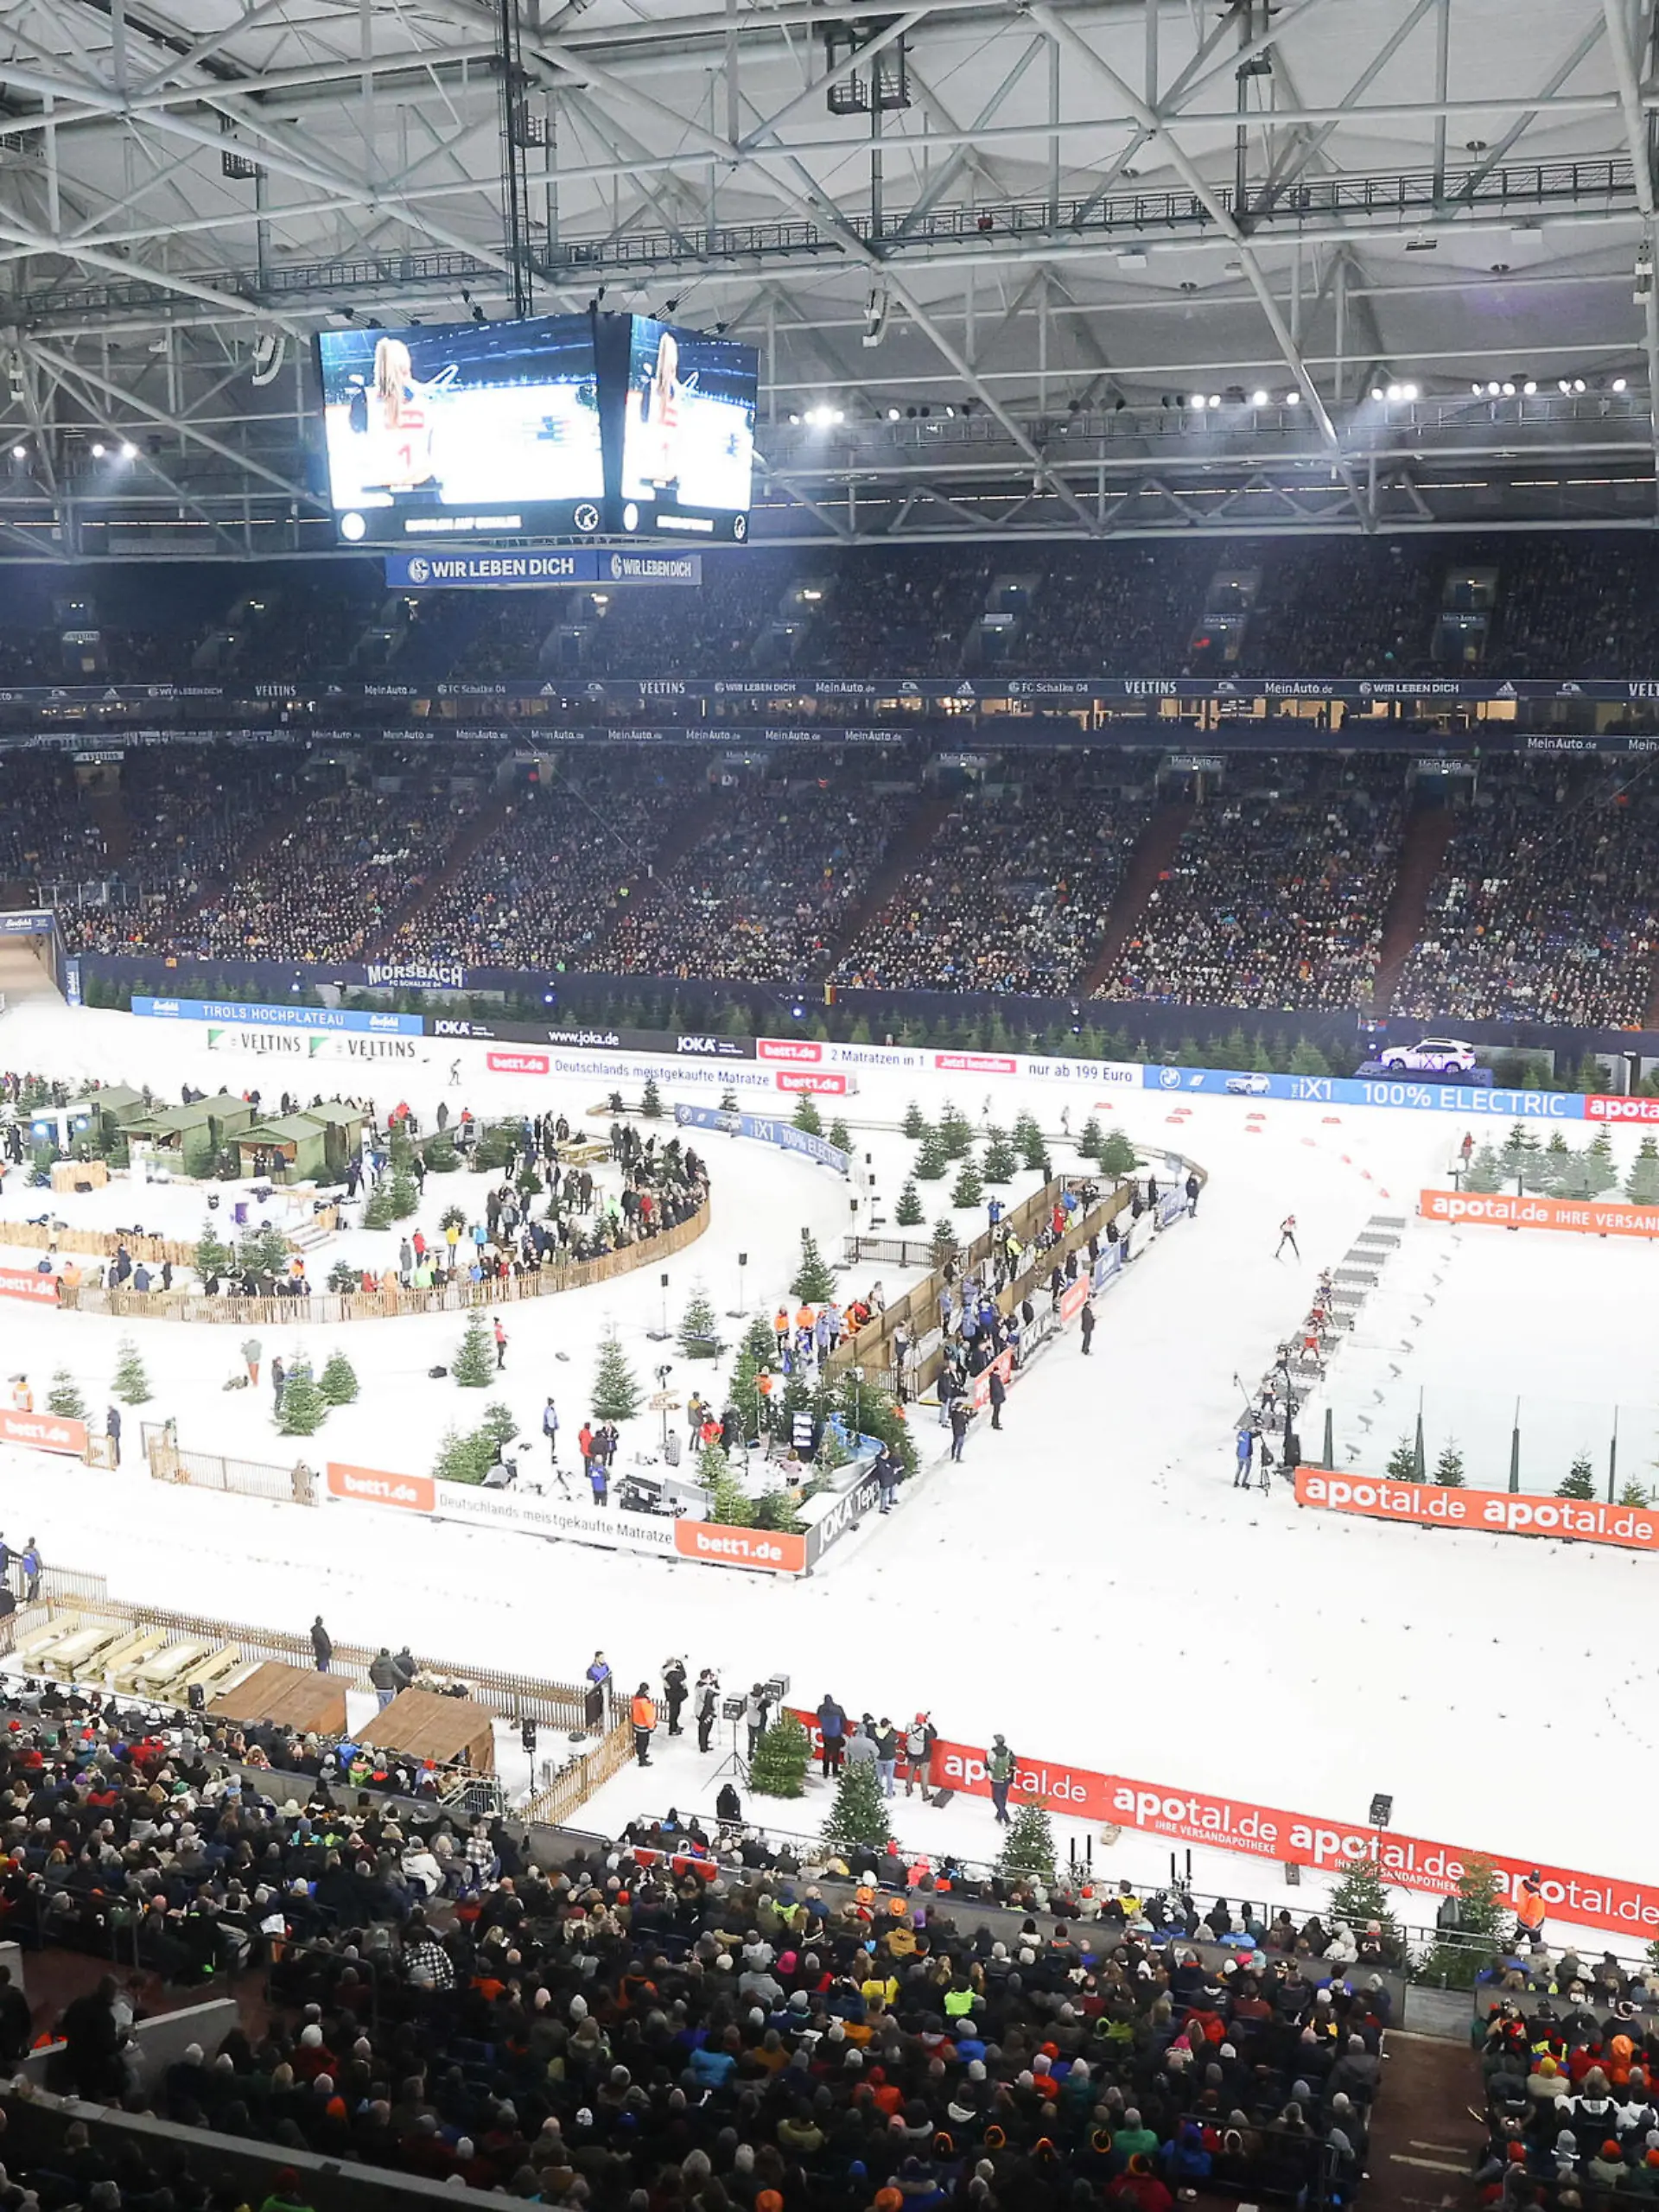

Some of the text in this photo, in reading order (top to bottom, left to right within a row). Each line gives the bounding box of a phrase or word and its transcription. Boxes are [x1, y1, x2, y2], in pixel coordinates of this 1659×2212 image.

[432, 557, 574, 578] WIR LEBEN DICH
[623, 558, 691, 577] WIR LEBEN DICH
[255, 685, 296, 696] VELTINS
[639, 683, 685, 694] VELTINS
[725, 683, 796, 692] WIR LEBEN DICH
[816, 683, 874, 693] MeinAuto.de
[1022, 683, 1088, 692] FC Schalke 04
[1125, 682, 1177, 694] VELTINS
[1265, 682, 1332, 694] MeinAuto.de
[1374, 683, 1459, 693] WIR LEBEN DICH
[1528, 737, 1597, 749] MeinAuto.de
[1629, 739, 1659, 751] Mein
[367, 964, 463, 988] MORSBACH
[203, 1005, 344, 1027] TIROLS HOCHPLATEAU
[435, 1020, 470, 1035] JOKA
[241, 1033, 301, 1052] VELTINS
[348, 1039, 415, 1058] VELTINS
[549, 1031, 619, 1046] www.joka.de
[677, 1036, 715, 1052] JOKA
[831, 1049, 925, 1066] 2 Matratzen in 1
[556, 1060, 769, 1086] Deutschlands meistgekaufte Matratze
[1029, 1064, 1133, 1083] nur ab 199 Euro
[1300, 1077, 1332, 1099] iX1
[1362, 1083, 1566, 1116] 100% ELECTRIC
[782, 1128, 807, 1151] 100%
[1433, 1197, 1659, 1231] apotal.de IHRE VERSAN
[343, 1473, 418, 1503] bett1.de
[1306, 1477, 1465, 1519] apotal.de
[440, 1493, 672, 1544] Deutschlands meistgekaufte Matratze
[818, 1496, 853, 1554] JOKA
[1483, 1498, 1654, 1541] apotal.de
[696, 1532, 783, 1561] bett1.de
[944, 1754, 1087, 1803] aptal.de
[1113, 1787, 1278, 1842] apotal.de
[1155, 1819, 1276, 1855] IHRE VERSANDAPOTHEKE
[1289, 1823, 1465, 1881] apotal.de
